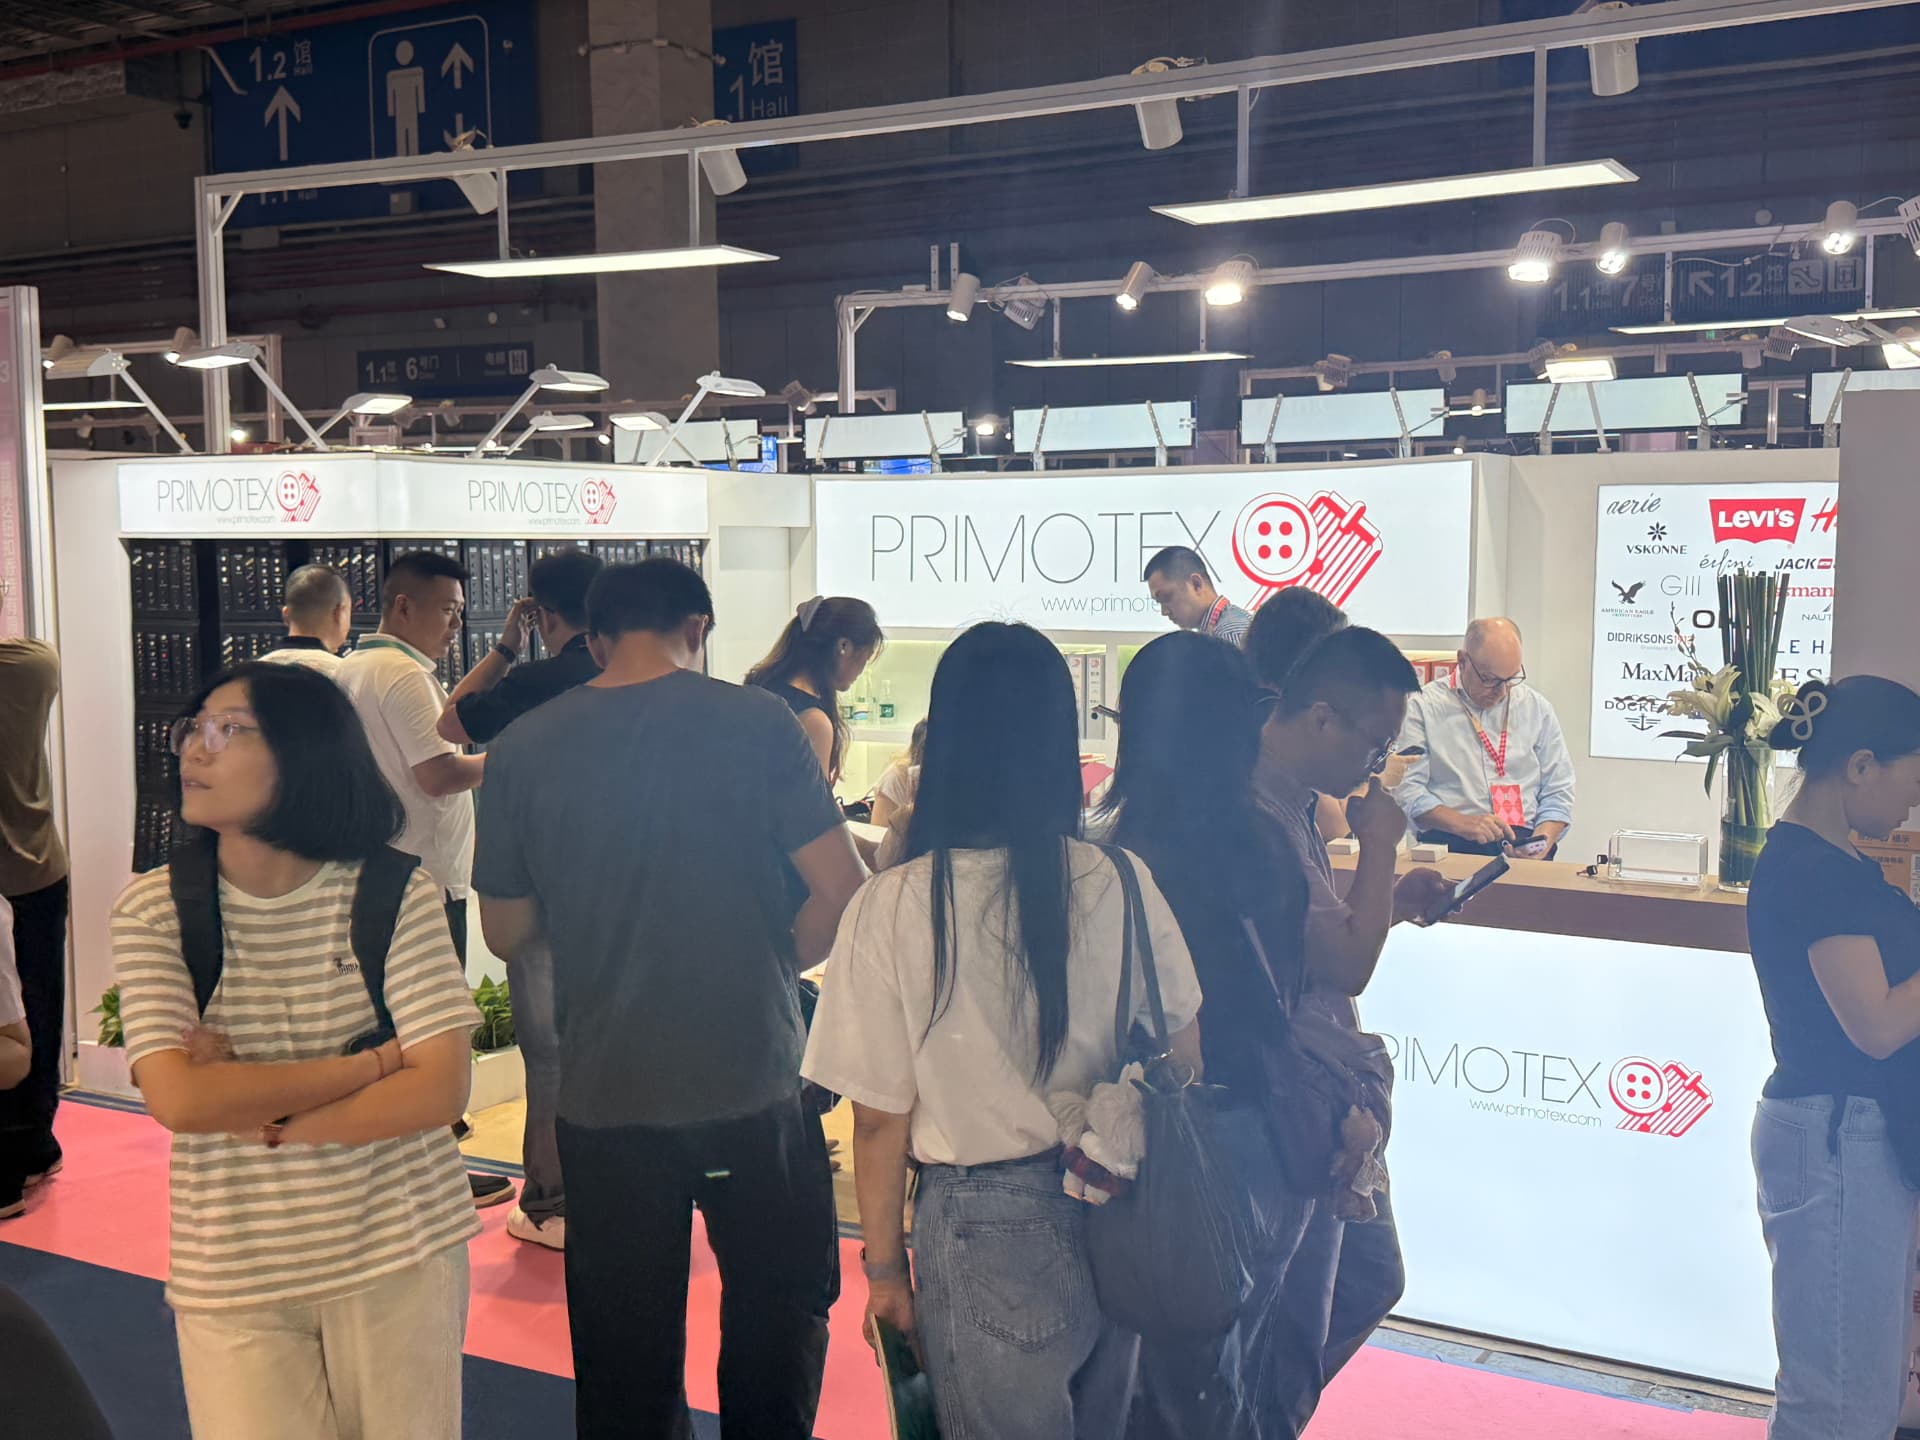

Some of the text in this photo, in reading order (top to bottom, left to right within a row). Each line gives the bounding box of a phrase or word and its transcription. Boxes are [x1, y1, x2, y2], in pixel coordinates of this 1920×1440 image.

[249, 46, 287, 83] 1.2
[748, 38, 784, 86] 馆
[751, 95, 788, 119] Hall
[1620, 274, 1639, 307] 7
[406, 357, 418, 380] 6
[157, 479, 275, 513] PRIMOTEX
[468, 480, 580, 514] PRIMOTEX
[1607, 492, 1661, 515] aerie
[871, 510, 1222, 584] PRIMOTEX
[1626, 544, 1688, 555] VSKONNE
[1041, 592, 1160, 615] www.primote
[1801, 613, 1831, 621] NAUT
[1621, 661, 1694, 683] MaxMa
[1604, 700, 1660, 713] DOCKE
[1373, 1032, 1601, 1109] IMOTEX
[1469, 1098, 1602, 1129] www.primotex.com
